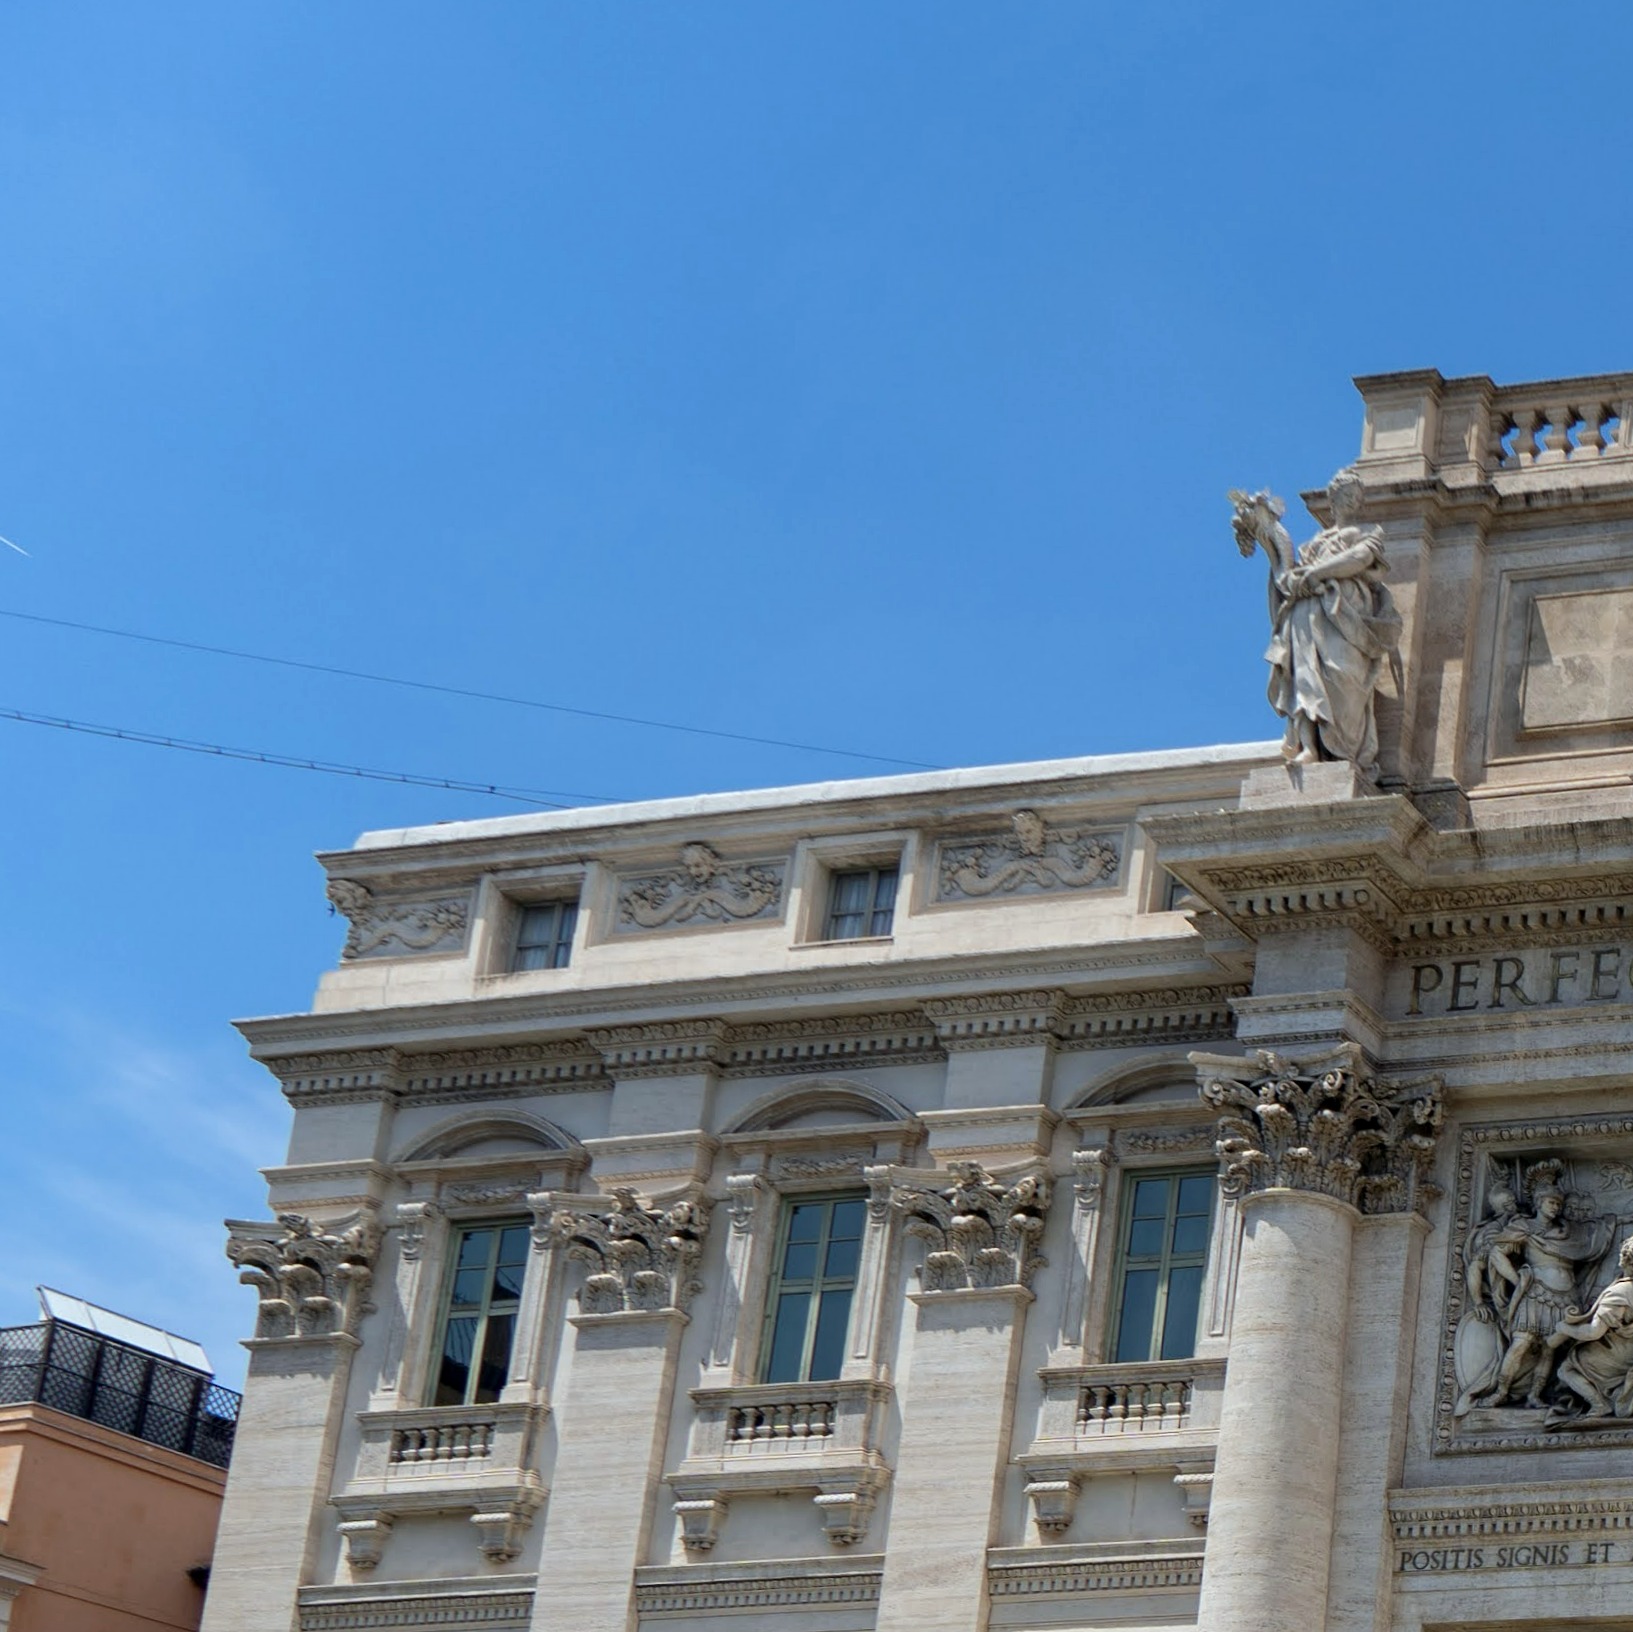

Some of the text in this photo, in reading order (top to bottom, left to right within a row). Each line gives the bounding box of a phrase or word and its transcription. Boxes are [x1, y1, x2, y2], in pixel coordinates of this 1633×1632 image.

[1400, 1548, 1484, 1571] POSITIS
[1496, 1543, 1570, 1568] SIGNIS
[1586, 1541, 1615, 1563] ET
